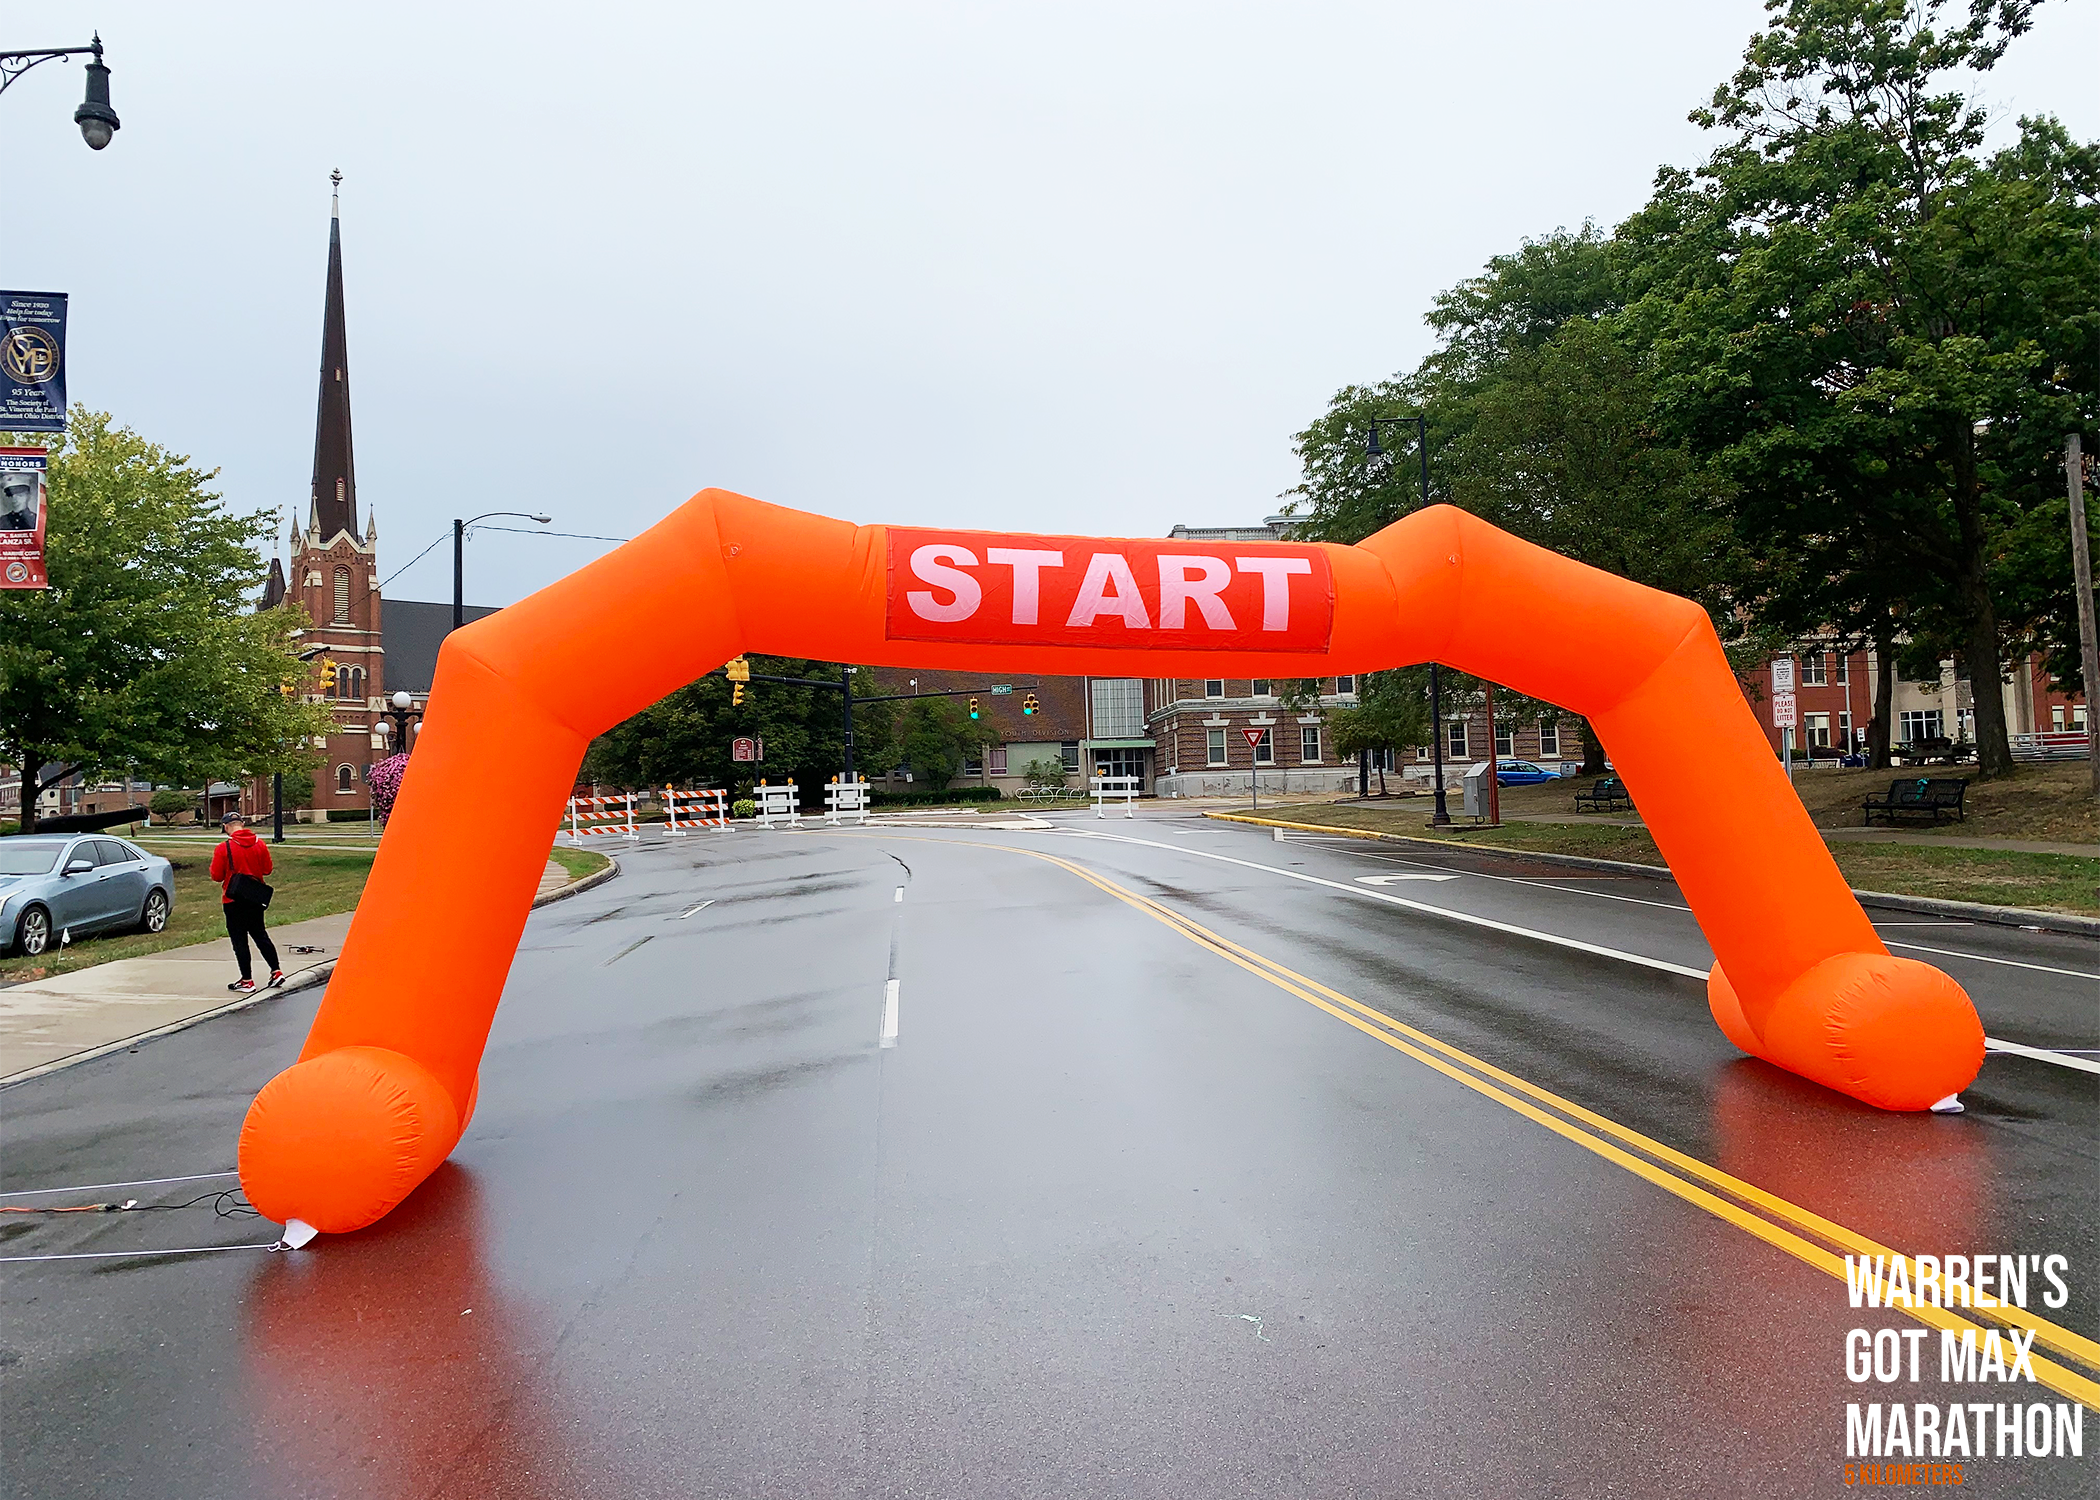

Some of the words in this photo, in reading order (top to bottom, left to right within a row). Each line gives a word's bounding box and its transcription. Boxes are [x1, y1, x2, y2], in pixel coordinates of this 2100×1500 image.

[11, 300, 32, 308] Since
[34, 310, 54, 318] today
[24, 388, 46, 396] Years
[906, 544, 1312, 632] START
